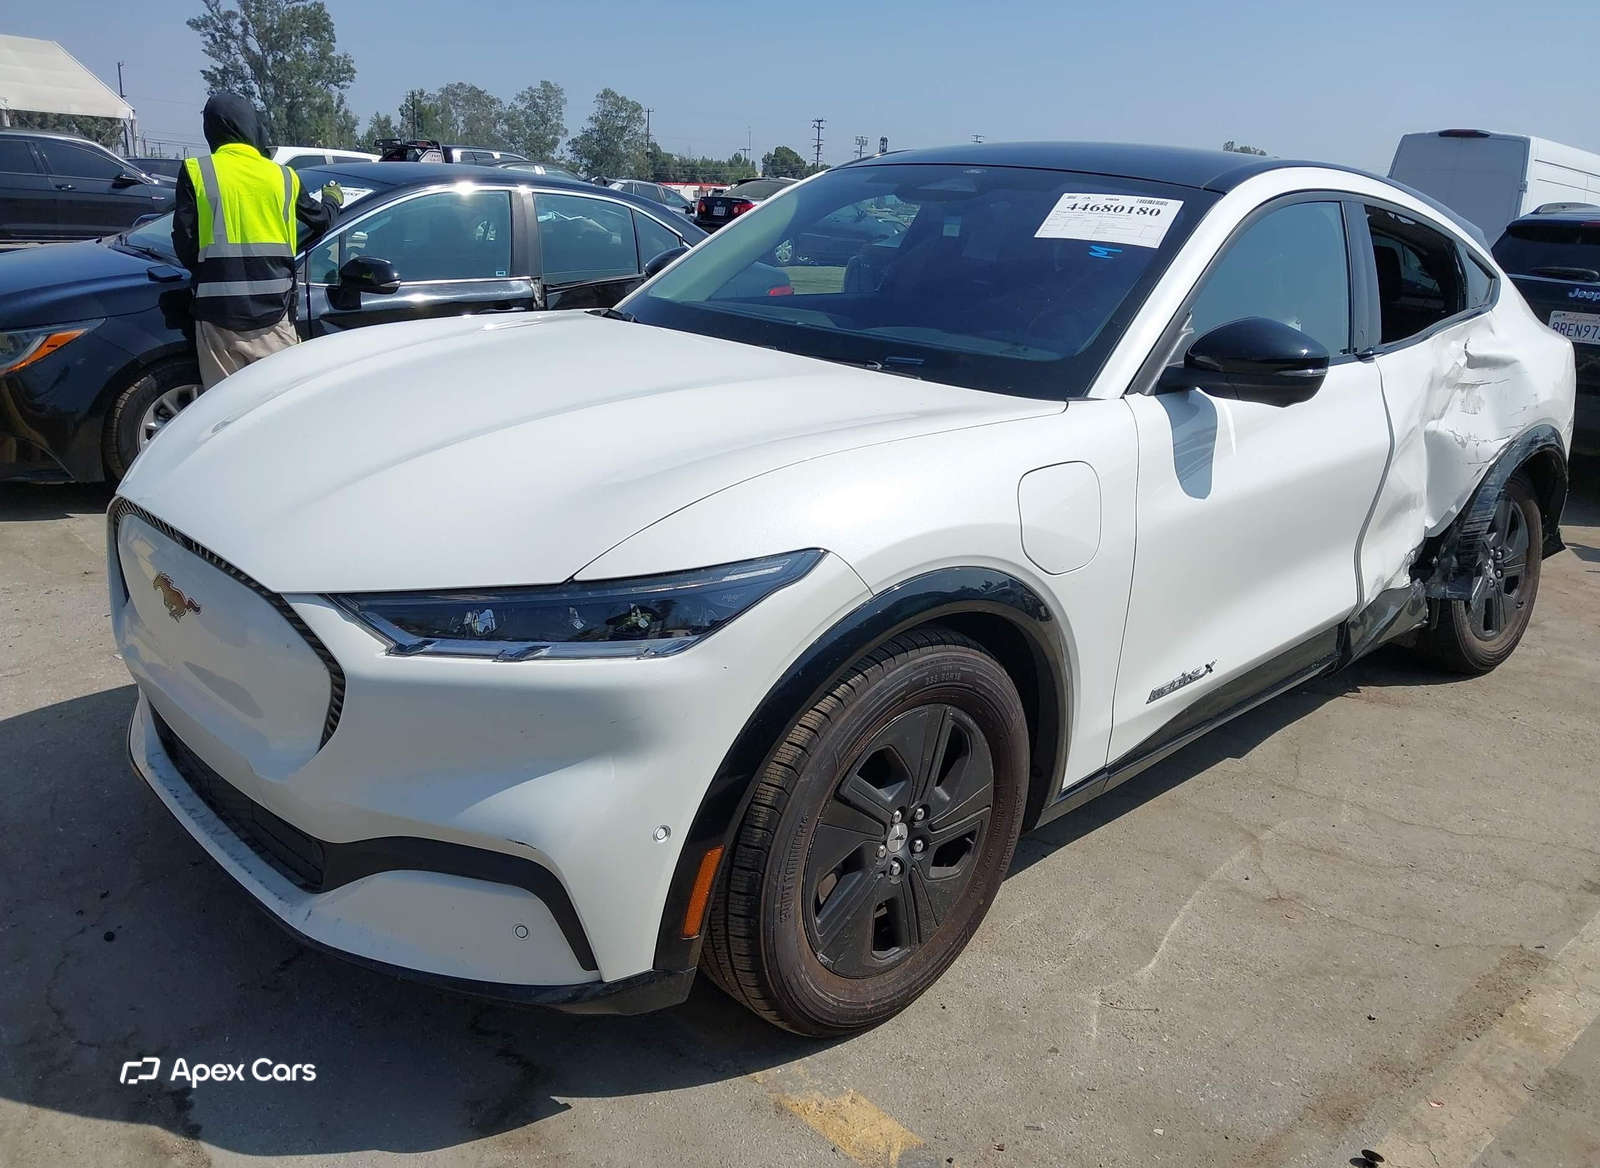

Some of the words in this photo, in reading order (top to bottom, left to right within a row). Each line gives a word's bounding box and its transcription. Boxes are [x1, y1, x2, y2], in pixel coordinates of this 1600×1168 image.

[1066, 202, 1161, 217] 44680180
[1569, 288, 1600, 301] Jeep
[1552, 322, 1600, 340] 8REN97
